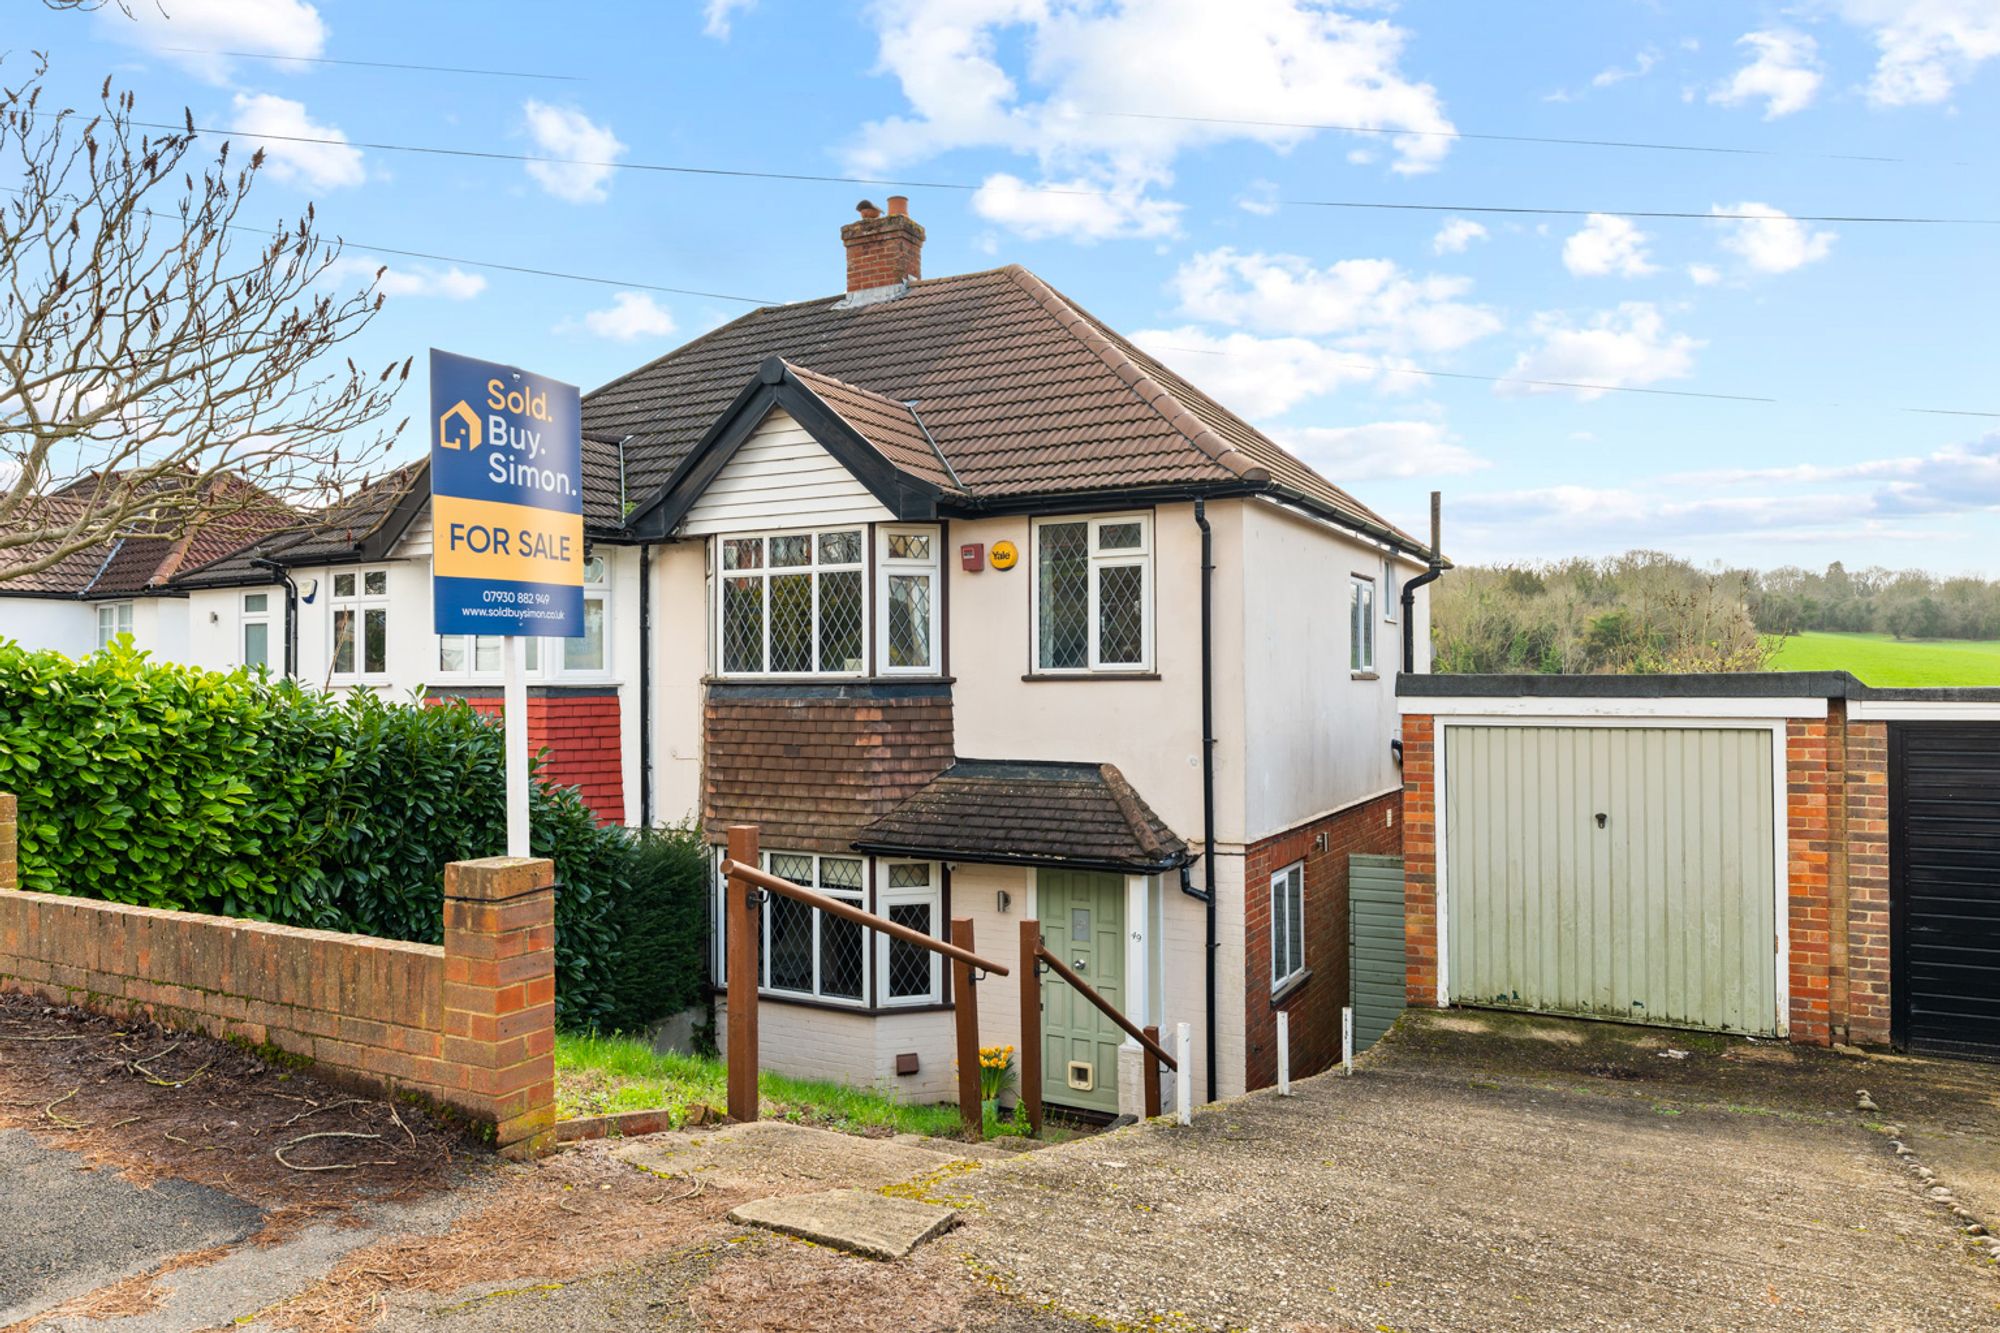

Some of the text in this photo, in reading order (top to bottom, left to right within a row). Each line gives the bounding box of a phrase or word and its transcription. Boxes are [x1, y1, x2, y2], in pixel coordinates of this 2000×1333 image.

[487, 379, 552, 422] Sold.
[489, 415, 545, 459] Buy.
[489, 452, 577, 496] Simon.
[450, 523, 571, 562] FOR SALE
[992, 551, 1011, 560] Yale
[462, 607, 565, 620] www.soldbuysimon.co.uk
[483, 591, 515, 603] 07930
[517, 593, 534, 604] 882
